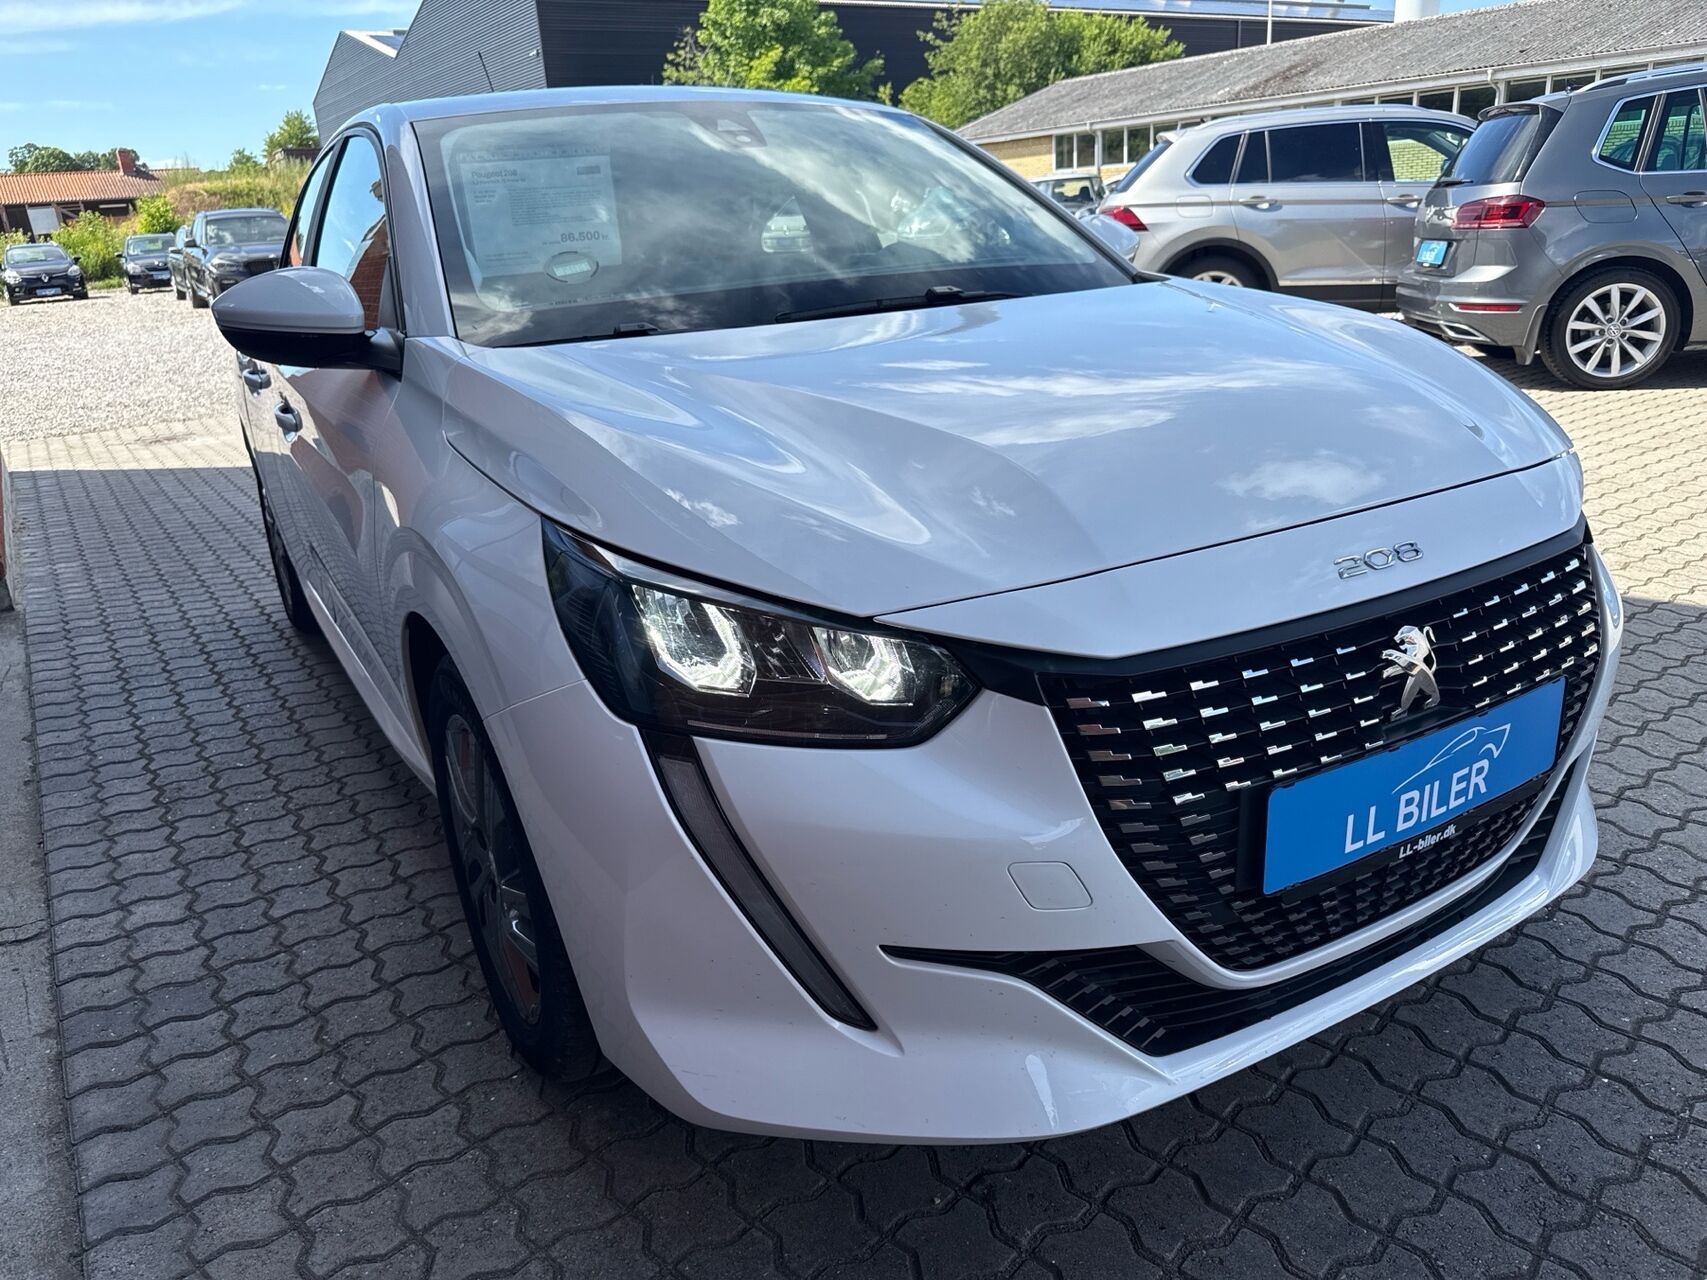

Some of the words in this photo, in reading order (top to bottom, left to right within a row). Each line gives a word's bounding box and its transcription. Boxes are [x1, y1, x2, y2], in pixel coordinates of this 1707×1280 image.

[560, 231, 600, 243] 86.500
[1333, 540, 1424, 580] 208
[1344, 805, 1386, 854] LL
[1396, 758, 1490, 833] BILER
[1398, 824, 1457, 859] LL-biler.dk
